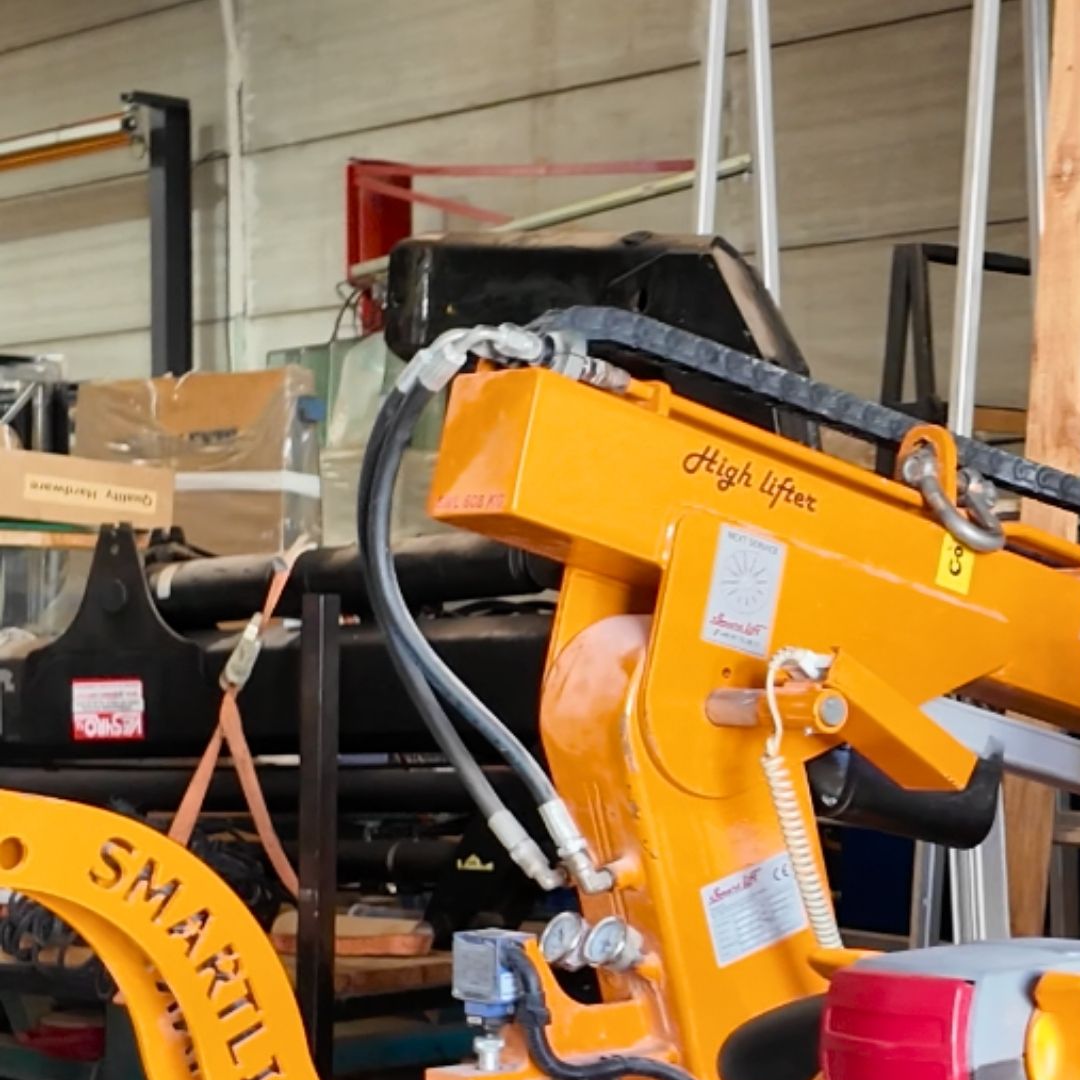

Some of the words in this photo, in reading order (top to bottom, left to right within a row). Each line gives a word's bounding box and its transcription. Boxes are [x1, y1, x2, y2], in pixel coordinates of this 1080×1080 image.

[682, 445, 752, 492] High
[759, 469, 818, 513] lifter
[29, 481, 98, 500] Hardware
[106, 488, 153, 507] Quality
